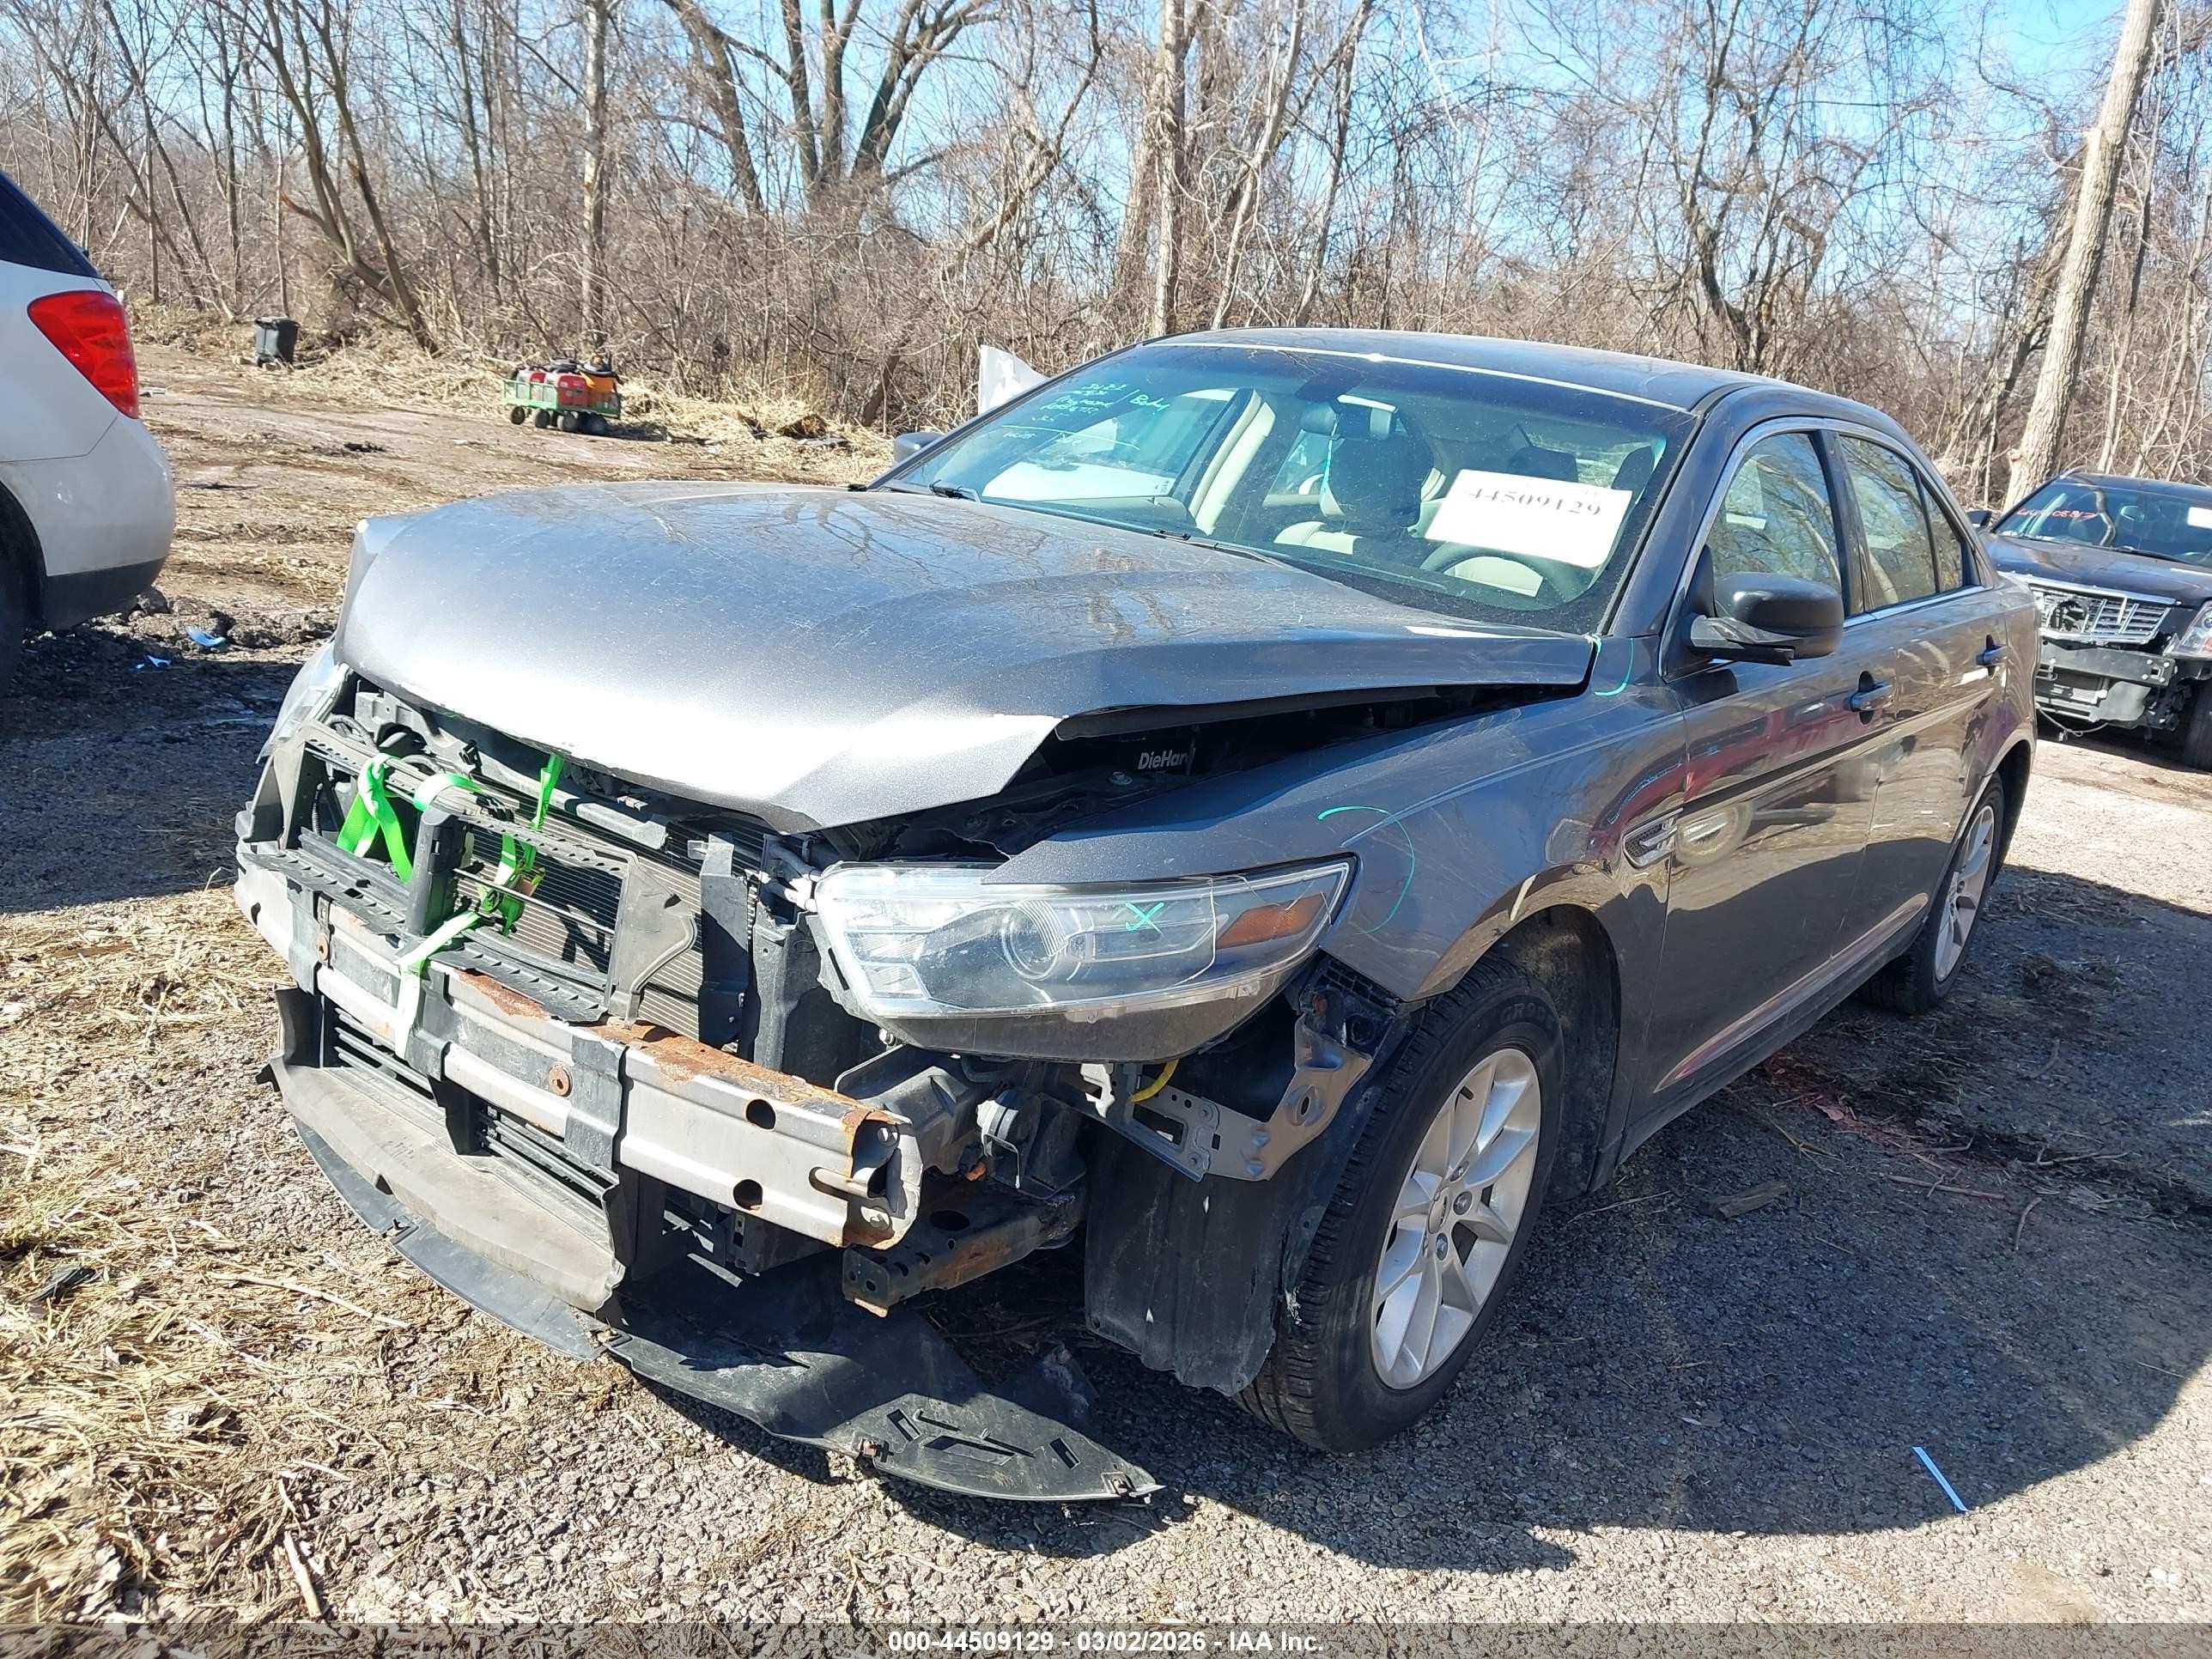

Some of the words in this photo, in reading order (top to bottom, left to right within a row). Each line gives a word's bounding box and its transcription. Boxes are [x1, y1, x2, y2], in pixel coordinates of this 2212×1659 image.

[1130, 394, 1170, 411] Body
[1467, 487, 1601, 516] 44509129
[1137, 749, 1190, 770] DieHar
